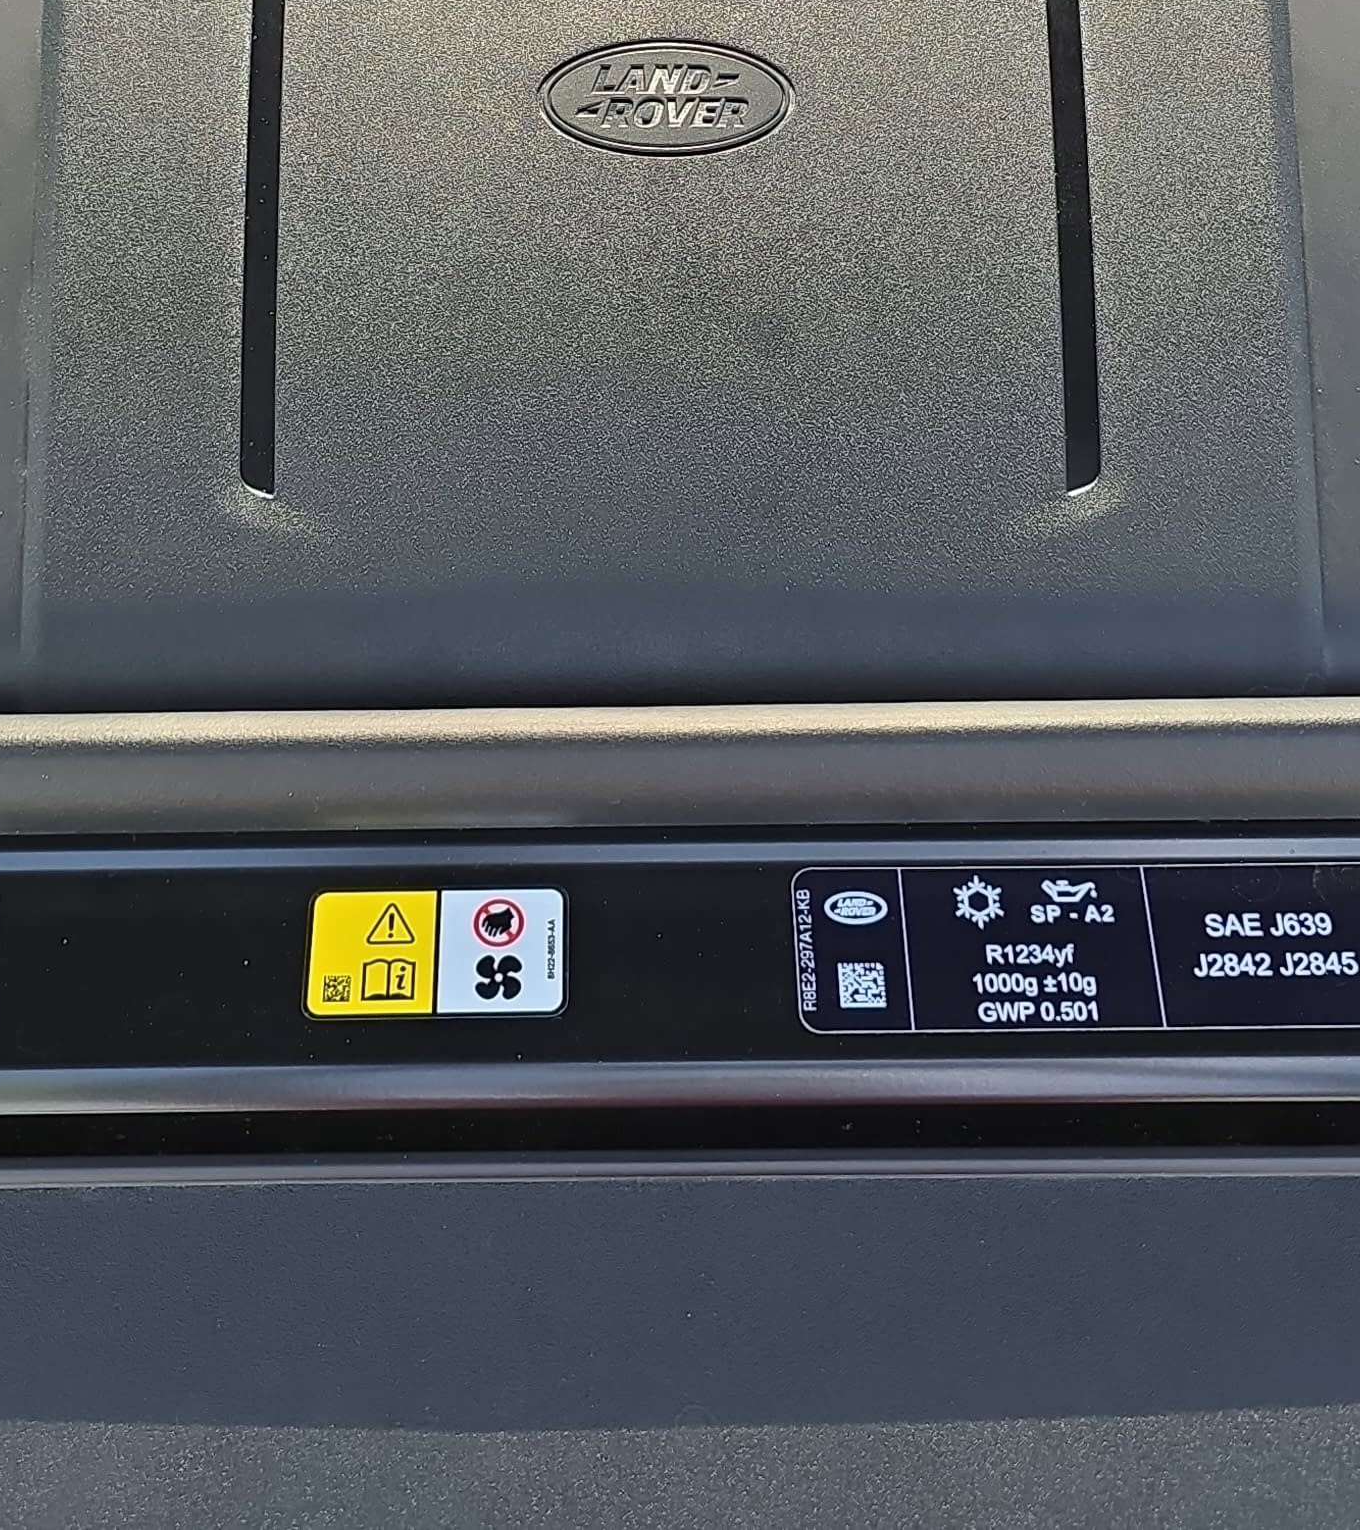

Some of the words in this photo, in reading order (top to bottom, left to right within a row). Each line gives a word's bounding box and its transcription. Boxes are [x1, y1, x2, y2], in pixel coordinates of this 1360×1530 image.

[591, 63, 713, 95] LAND
[598, 96, 750, 128] ROVER
[1030, 905, 1062, 923] SP
[1084, 905, 1116, 923] A2
[1204, 914, 1263, 937] SAE
[1270, 912, 1332, 937] J639
[985, 943, 1075, 968] R1234yf
[1193, 953, 1273, 978] J2842
[1278, 951, 1359, 976] J2845
[973, 972, 1039, 997] 1000g
[1043, 971, 1097, 996] ±10g
[977, 1002, 1036, 1023] GWP
[1040, 1001, 1099, 1022] 0.501
